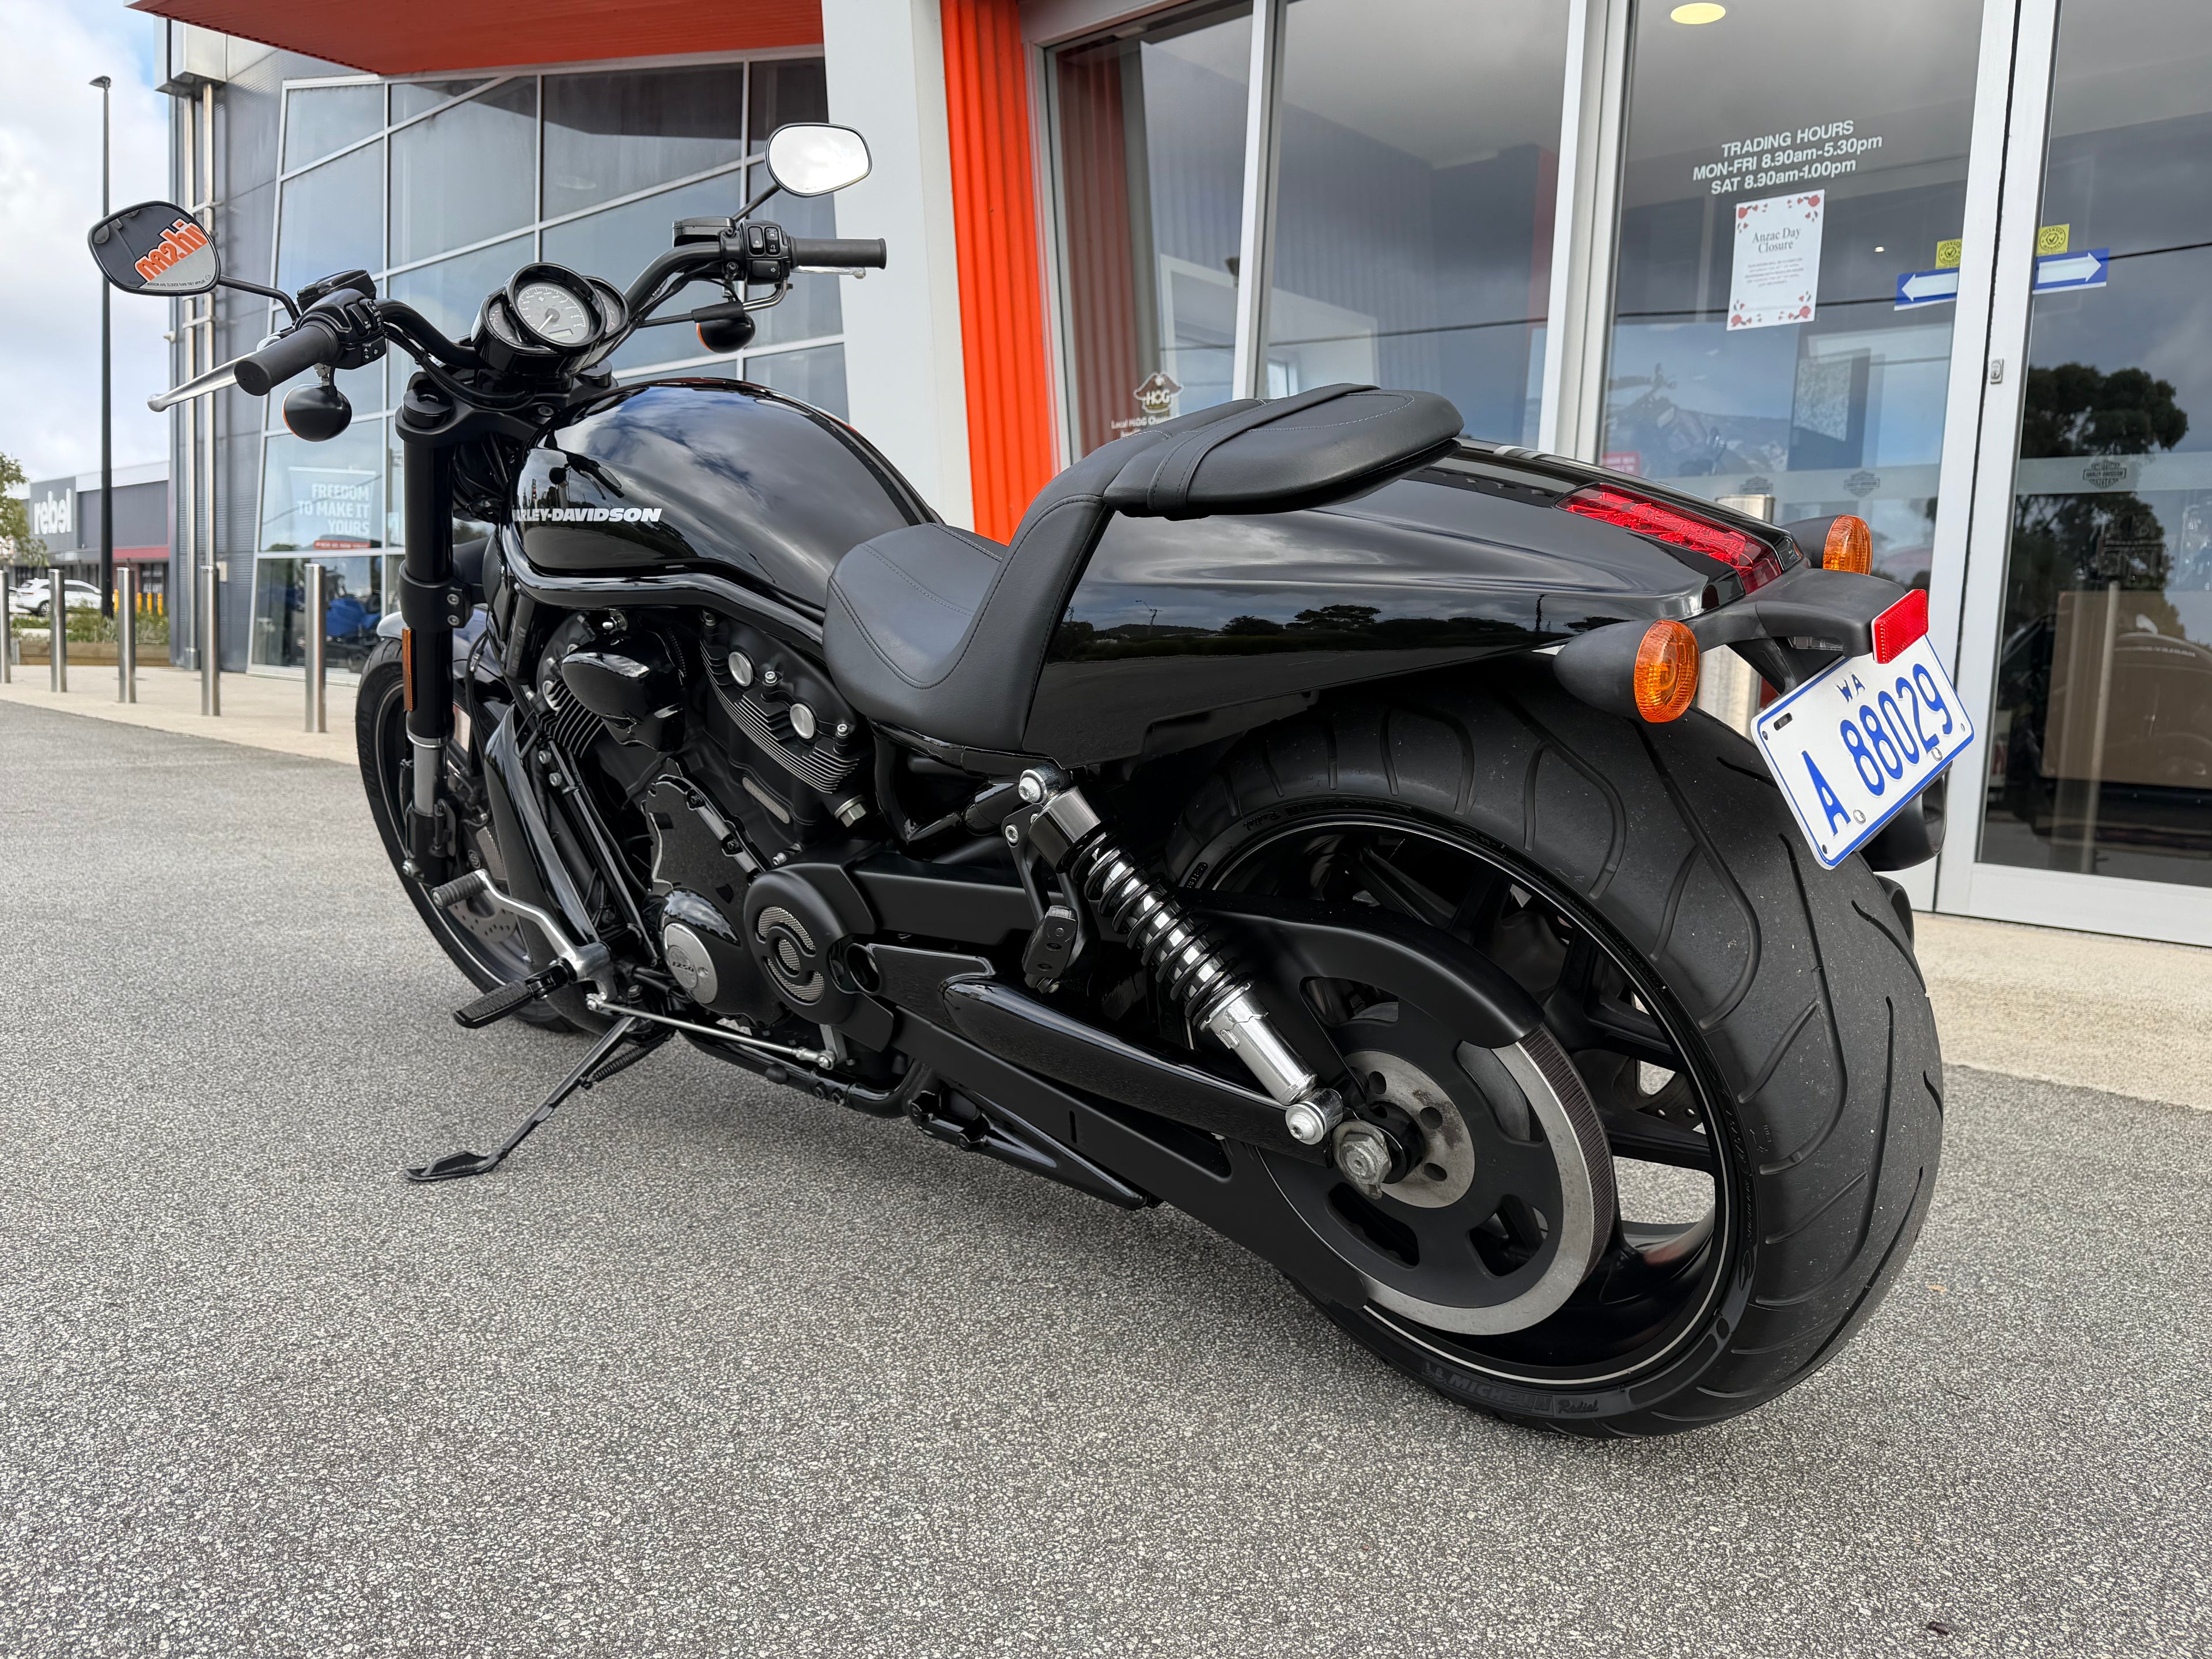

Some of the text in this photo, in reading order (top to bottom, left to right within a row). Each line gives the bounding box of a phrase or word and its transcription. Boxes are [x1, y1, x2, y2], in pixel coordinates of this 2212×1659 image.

[1722, 120, 1854, 158] TRADING HOURS
[1692, 156, 1758, 181] MON-FRI
[1710, 176, 1741, 195] SAT
[1752, 227, 1801, 244] Anzac Day
[1758, 240, 1793, 253] Closure
[1146, 389, 1171, 406] HOG
[312, 483, 370, 501] FREEDOM
[34, 488, 72, 535] rebel
[297, 499, 370, 518] TO MAKE IT
[328, 518, 370, 536] YOURS
[1836, 673, 1865, 703] WA
[1801, 663, 1953, 836] A 88029
[672, 961, 694, 974] 1250
[1447, 1373, 1599, 1414] MICHELIN Radial
